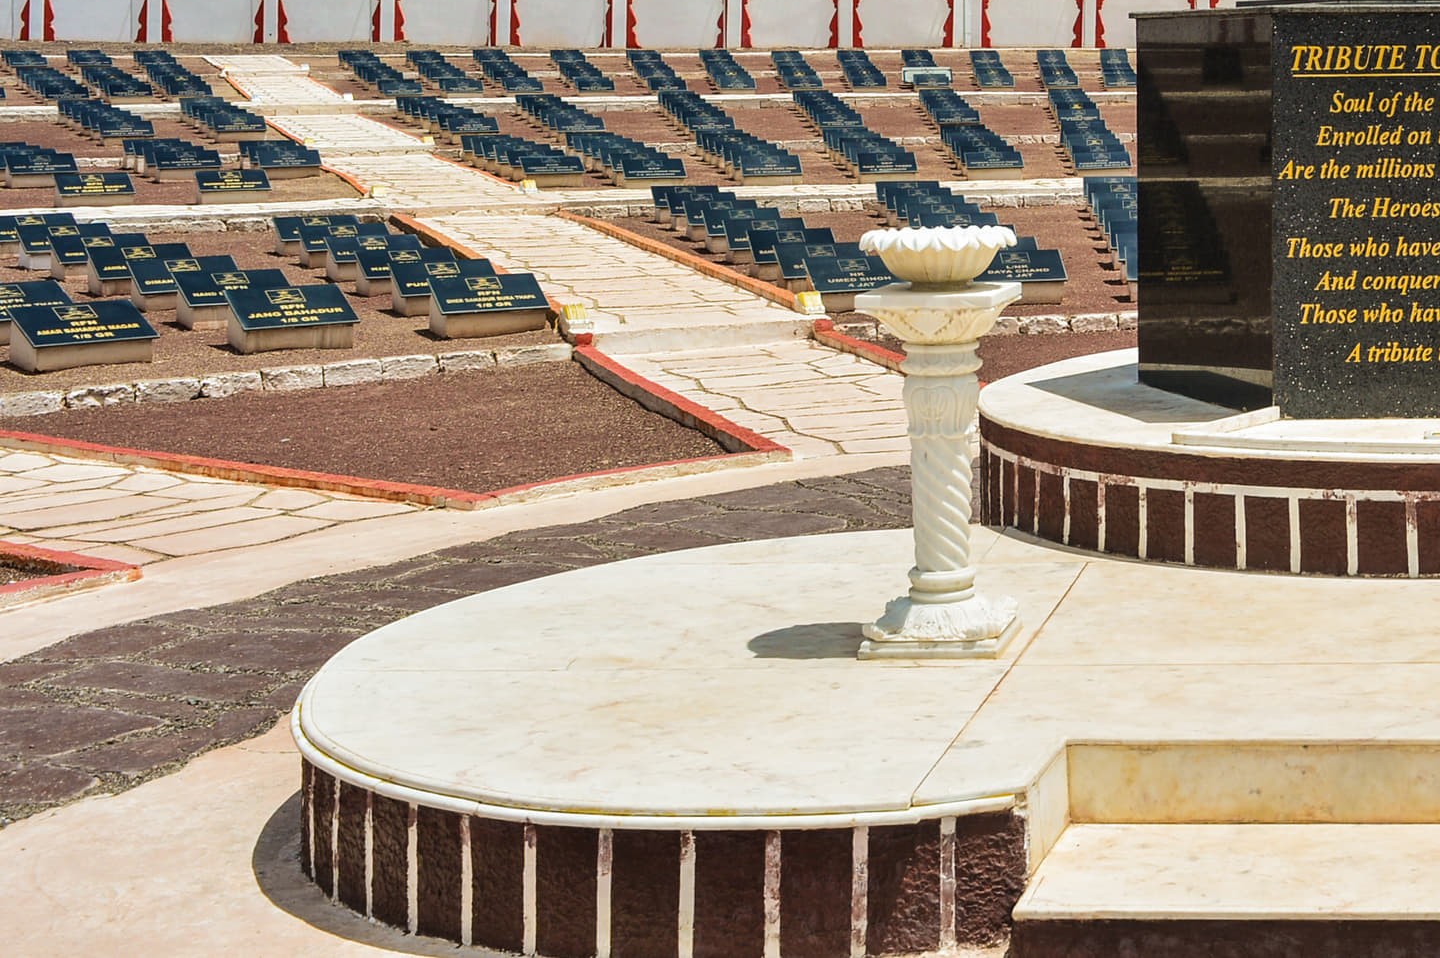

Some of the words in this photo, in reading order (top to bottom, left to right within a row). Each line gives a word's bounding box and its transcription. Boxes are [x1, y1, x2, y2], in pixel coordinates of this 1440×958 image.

[1291, 45, 1407, 71] TRIBUTE
[1330, 92, 1374, 113] Soul
[1379, 92, 1402, 117] of
[1404, 92, 1434, 112] the
[1316, 125, 1402, 146] Enrolled
[1407, 131, 1432, 145] on
[1278, 160, 1314, 180] Are
[1320, 159, 1350, 179] the
[1356, 158, 1435, 178] millions
[1329, 198, 1366, 219] The
[1371, 197, 1440, 218] Heroes
[1286, 237, 1344, 259] Those
[1349, 237, 1389, 258] who
[1315, 270, 1358, 291] And
[1300, 304, 1357, 324] Those
[1363, 303, 1403, 323] who
[1346, 343, 1362, 363] A
[1368, 342, 1433, 362] tribute
